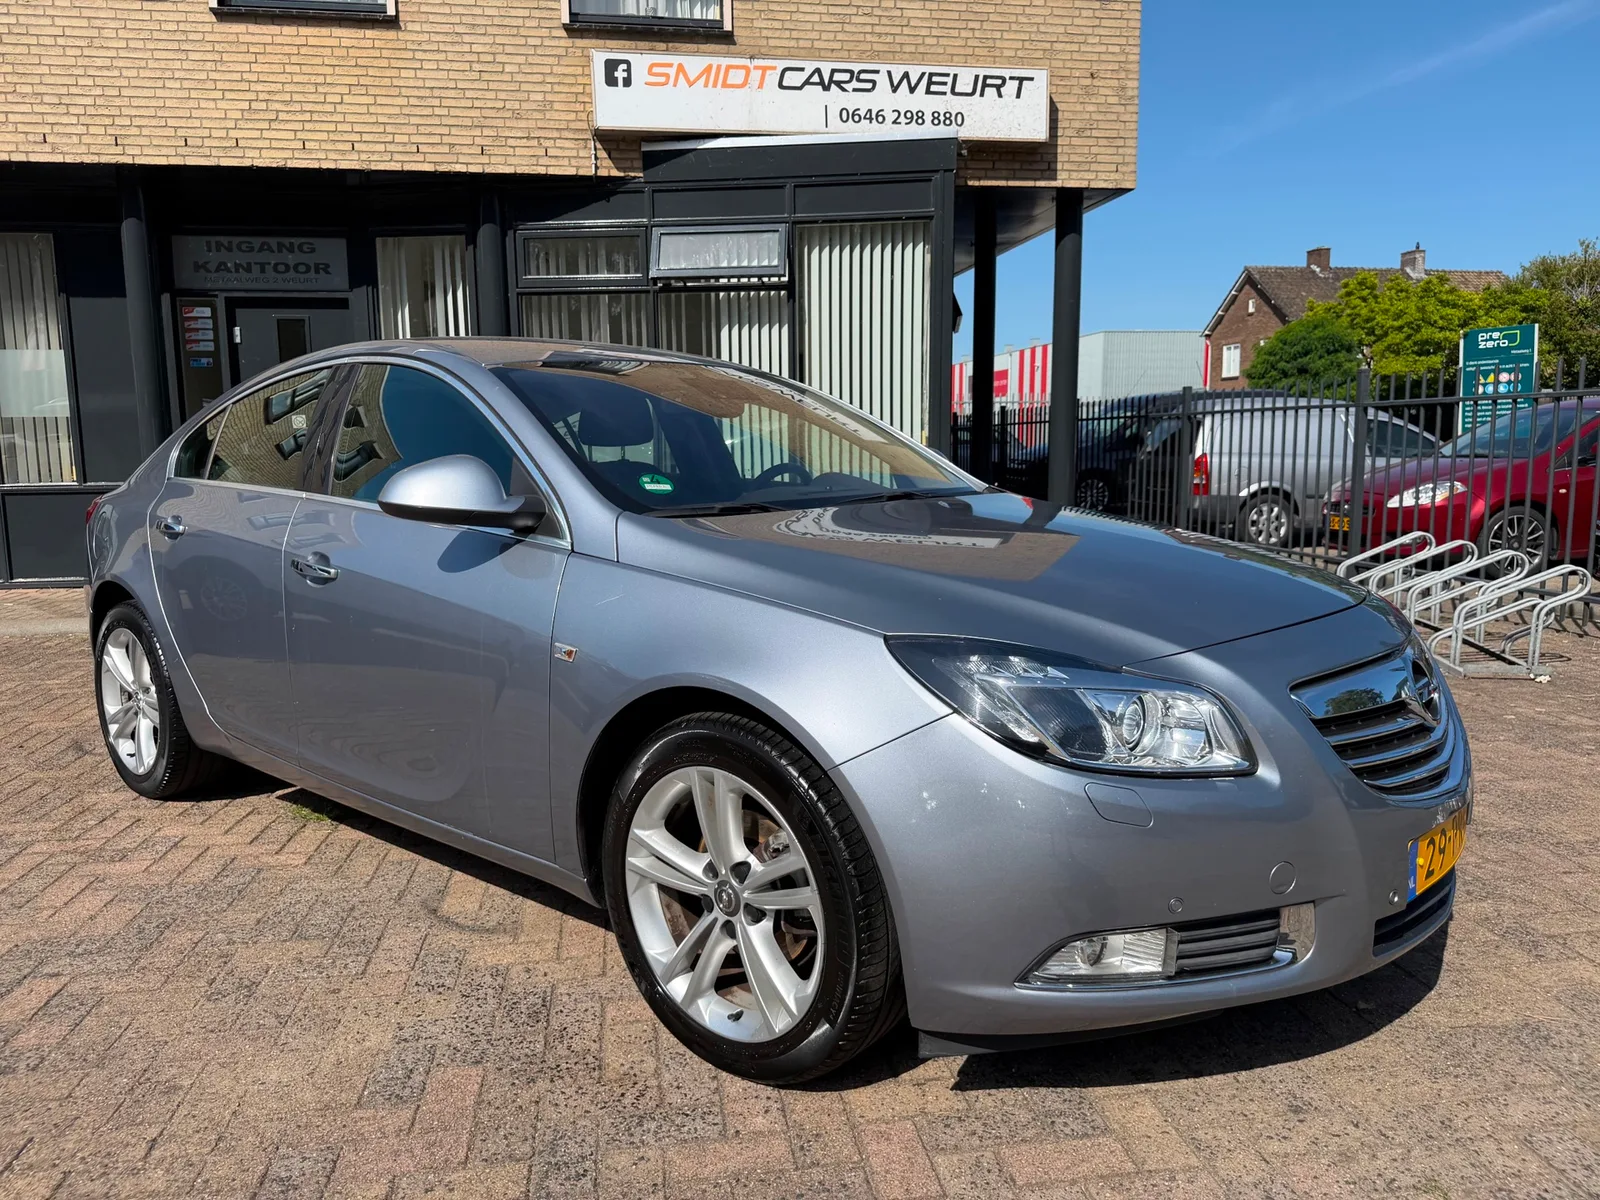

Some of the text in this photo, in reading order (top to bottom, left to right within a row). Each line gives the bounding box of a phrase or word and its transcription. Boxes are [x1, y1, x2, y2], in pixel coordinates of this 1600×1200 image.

[644, 62, 1035, 100] SMIDT CARS WEURT
[838, 107, 965, 128] 0646 298 880
[205, 240, 317, 254] INGANG
[193, 260, 332, 275] KANTOOR
[204, 276, 270, 285] METAALWEG
[281, 277, 320, 285] WEURT
[1478, 331, 1501, 342] pre
[1478, 339, 1509, 349] zero
